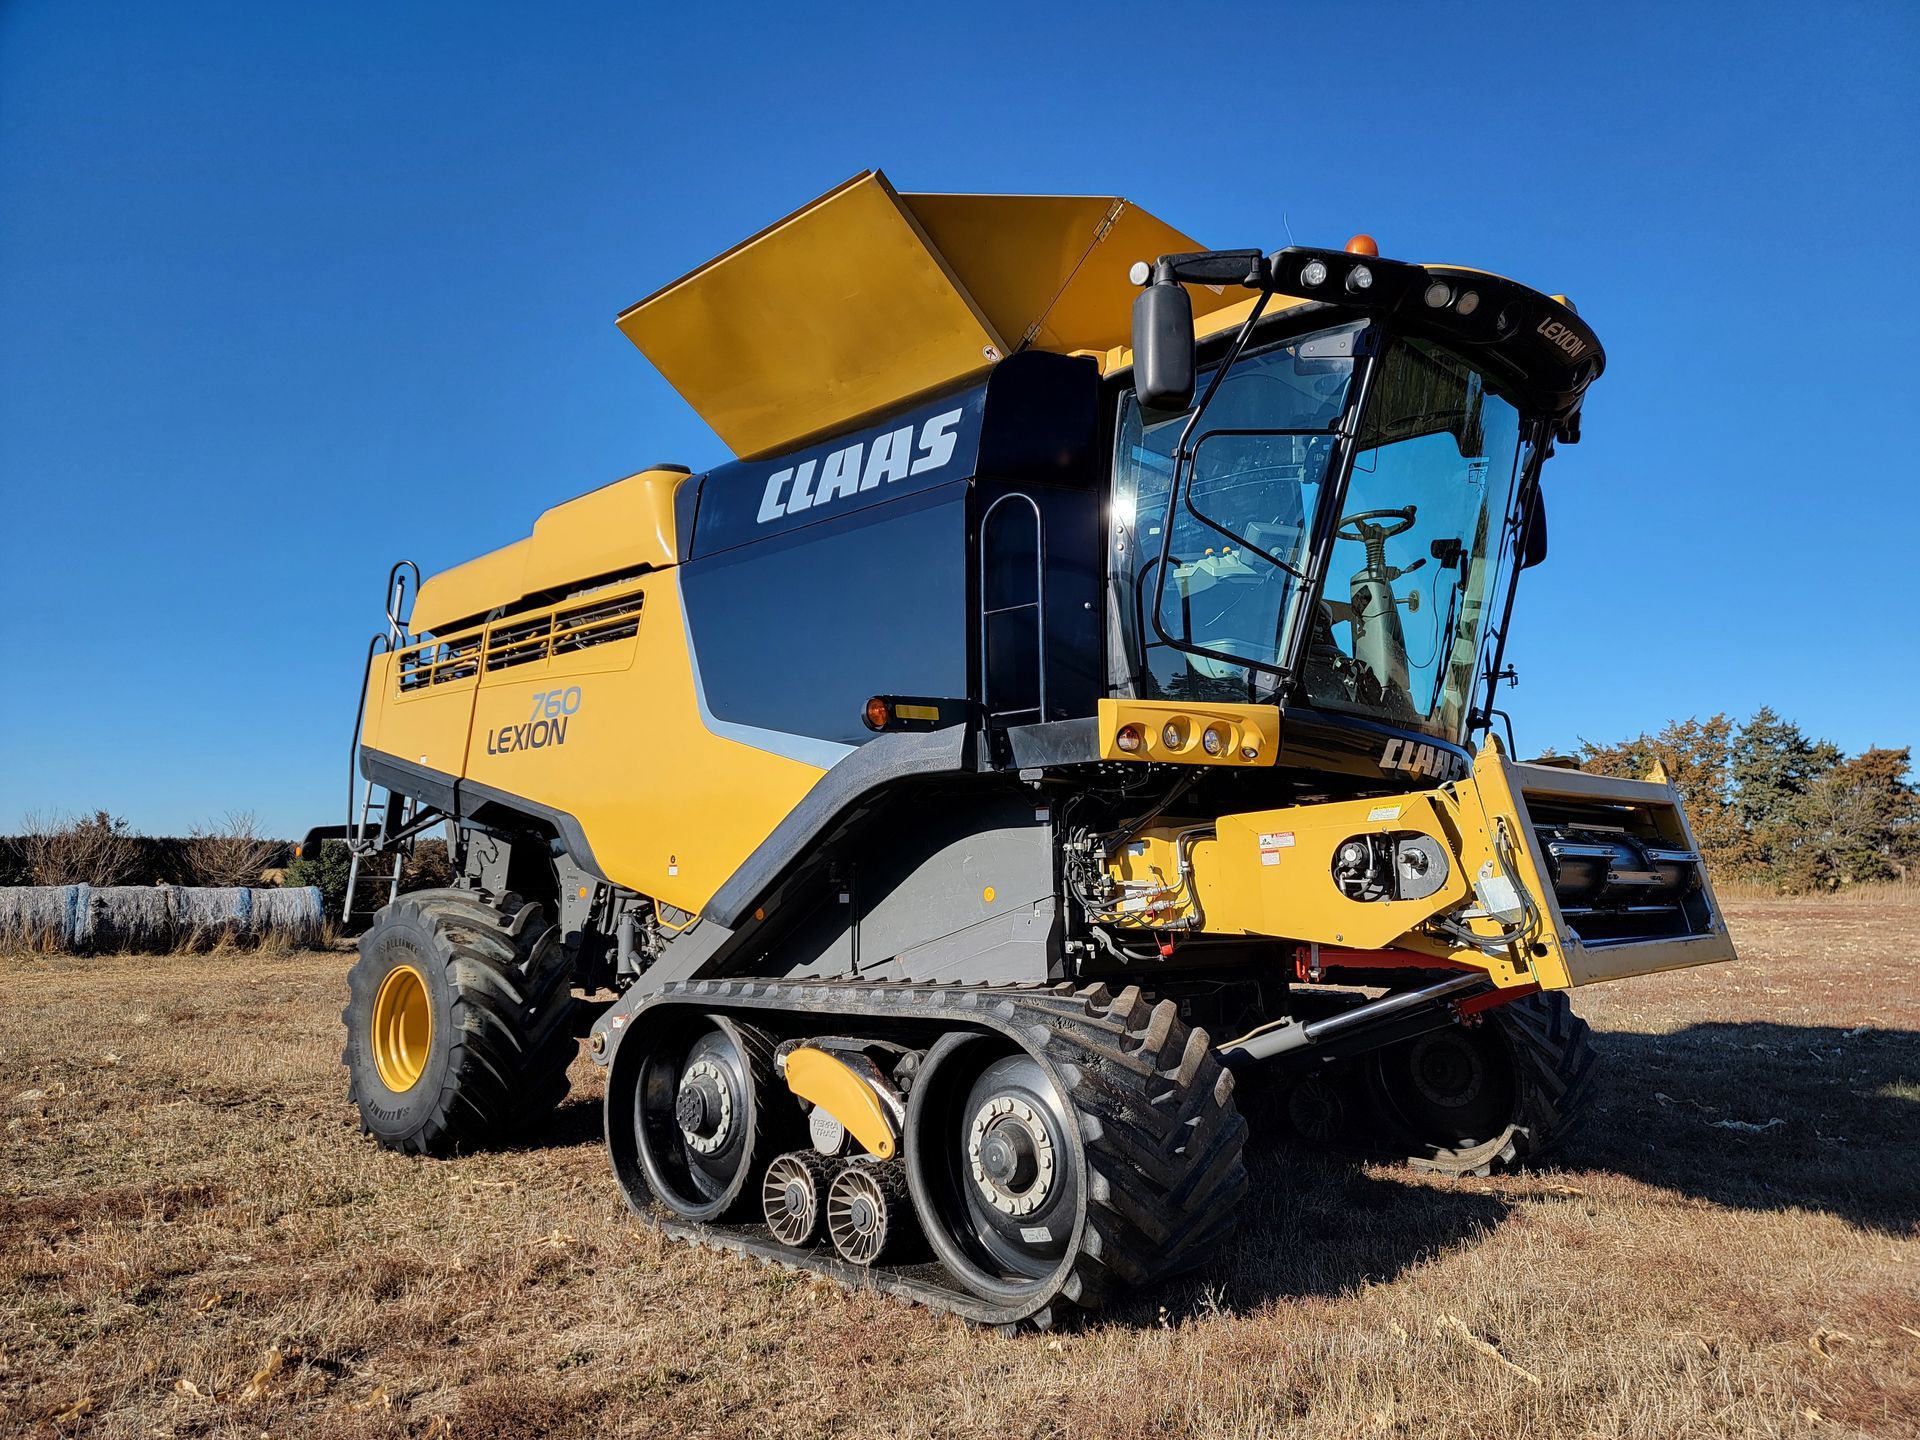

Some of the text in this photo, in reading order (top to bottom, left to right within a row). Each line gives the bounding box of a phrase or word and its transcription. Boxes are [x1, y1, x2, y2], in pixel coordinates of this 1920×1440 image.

[1537, 316, 1586, 358] LEXION
[757, 408, 963, 524] CLAAS
[530, 686, 582, 721] 760
[487, 716, 568, 755] LEXION
[1379, 738, 1463, 780] CLAAS
[367, 1098, 404, 1121] ALLIANCE
[813, 1119, 839, 1130] TERRA
[815, 1128, 836, 1138] TRAC
